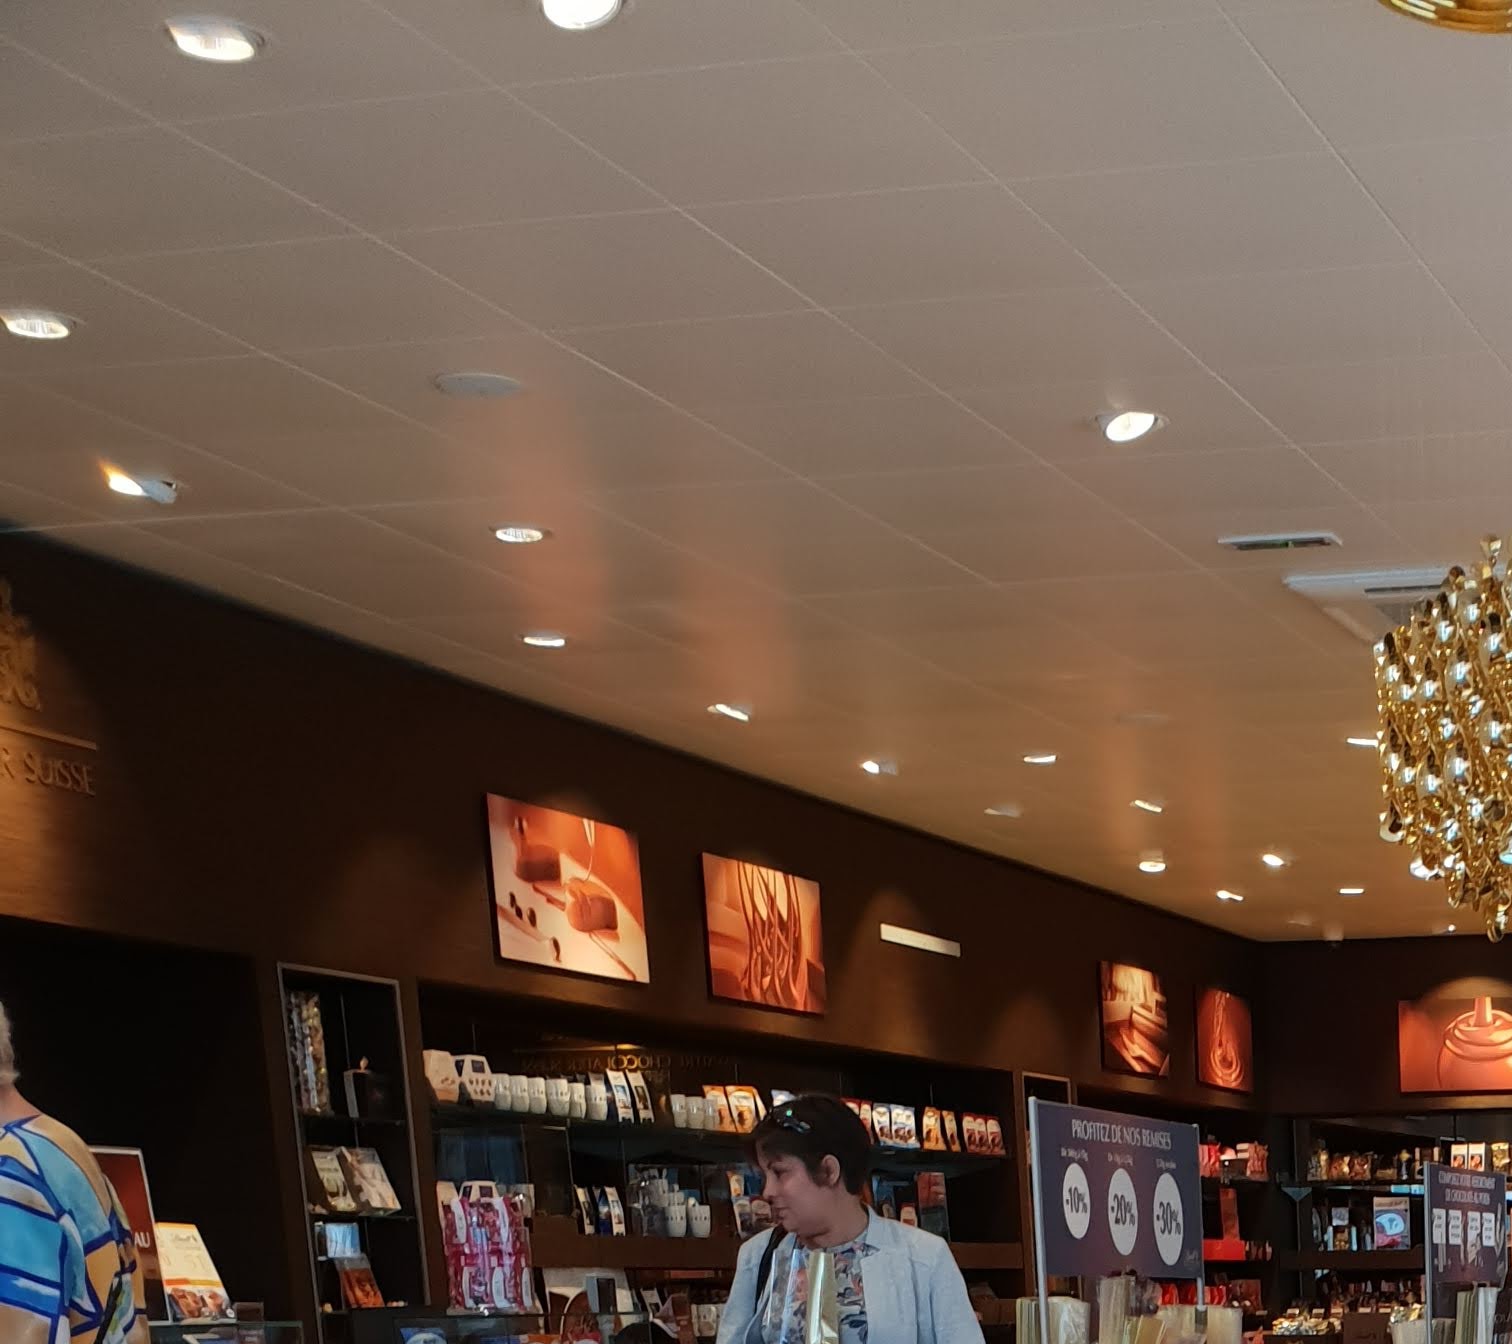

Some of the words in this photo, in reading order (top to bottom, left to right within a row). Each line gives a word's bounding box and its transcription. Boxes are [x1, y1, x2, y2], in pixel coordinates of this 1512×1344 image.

[1071, 1119, 1110, 1143] PROFITEZ
[1111, 1125, 1122, 1143] DE
[1123, 1127, 1141, 1147] NOS
[1142, 1130, 1171, 1150] REMISES
[1065, 1186, 1088, 1214] -10%
[1111, 1193, 1136, 1226] -20%
[1156, 1201, 1182, 1236] -30%
